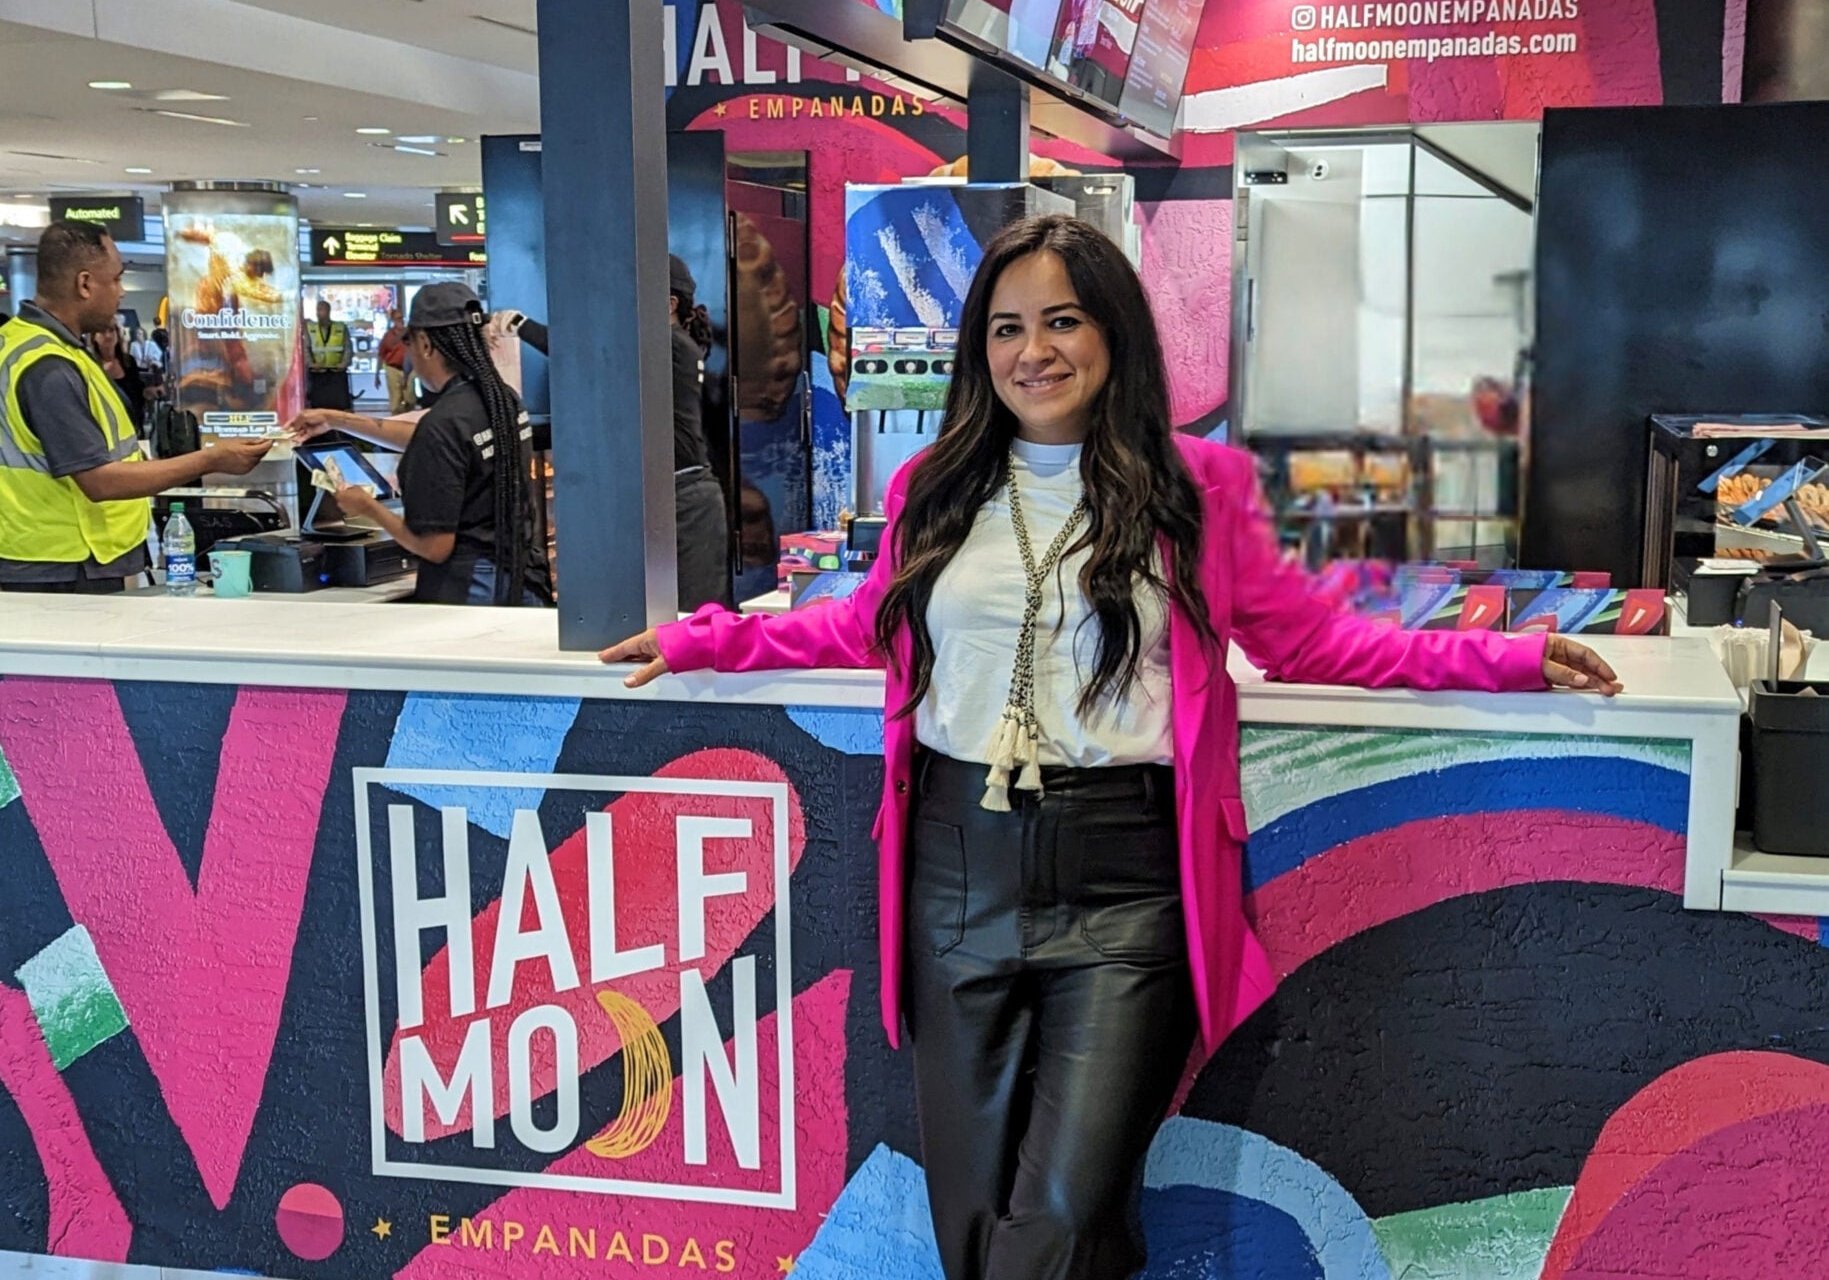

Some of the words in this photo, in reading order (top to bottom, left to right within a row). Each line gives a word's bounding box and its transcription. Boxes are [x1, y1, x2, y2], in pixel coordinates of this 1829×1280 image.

[1320, 0, 1578, 29] HALFMOONEMPANADAS
[663, 3, 801, 86] AL
[1291, 31, 1577, 63] halfmoonempanadas.com
[750, 94, 924, 119] EMPANADAS
[65, 207, 120, 219] Automated
[379, 233, 402, 243] Claim
[182, 308, 291, 329] Confidence.
[168, 563, 194, 573] 100%
[388, 804, 752, 1030] HALF
[431, 1215, 736, 1273] EMPANADAS
